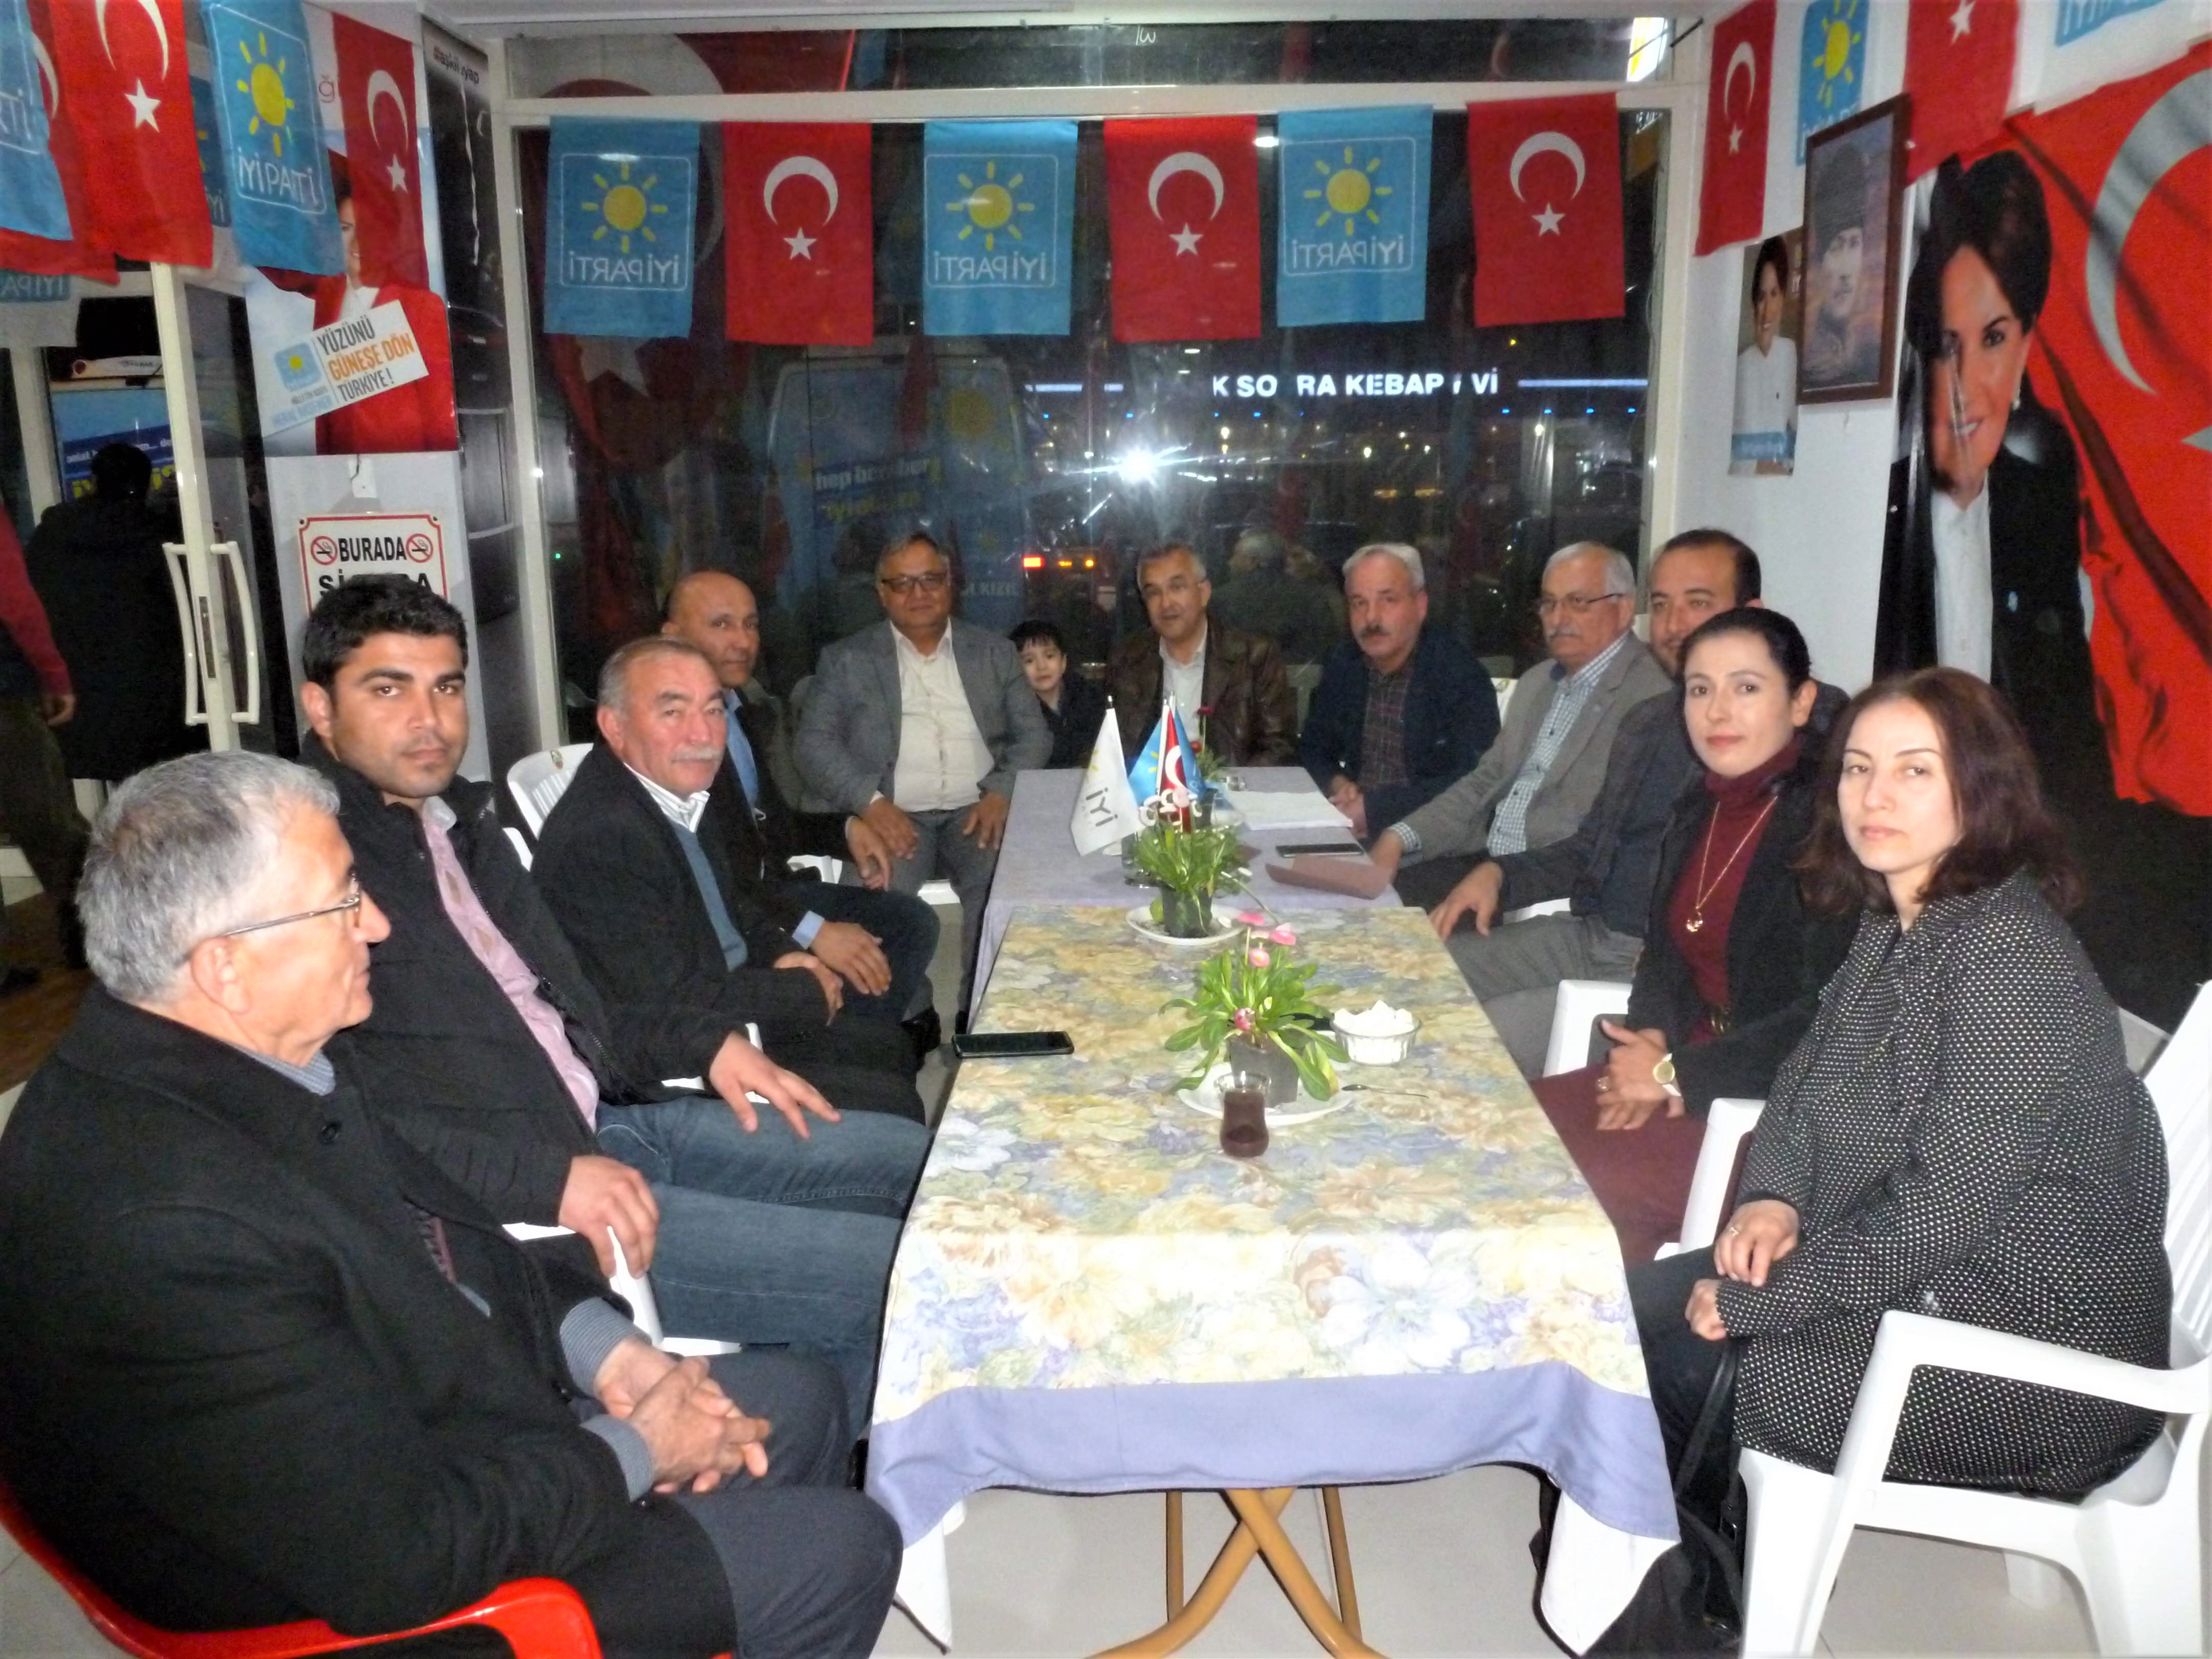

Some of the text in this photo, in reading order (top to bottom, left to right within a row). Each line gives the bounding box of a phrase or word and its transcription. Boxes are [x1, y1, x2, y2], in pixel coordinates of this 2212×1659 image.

[317, 314, 376, 355] YÜZÜNÜ
[382, 332, 416, 361] DÖN
[1345, 373, 1444, 396] KEBAP
[338, 537, 408, 562] BURADA
[1086, 787, 1118, 827] İYİ
